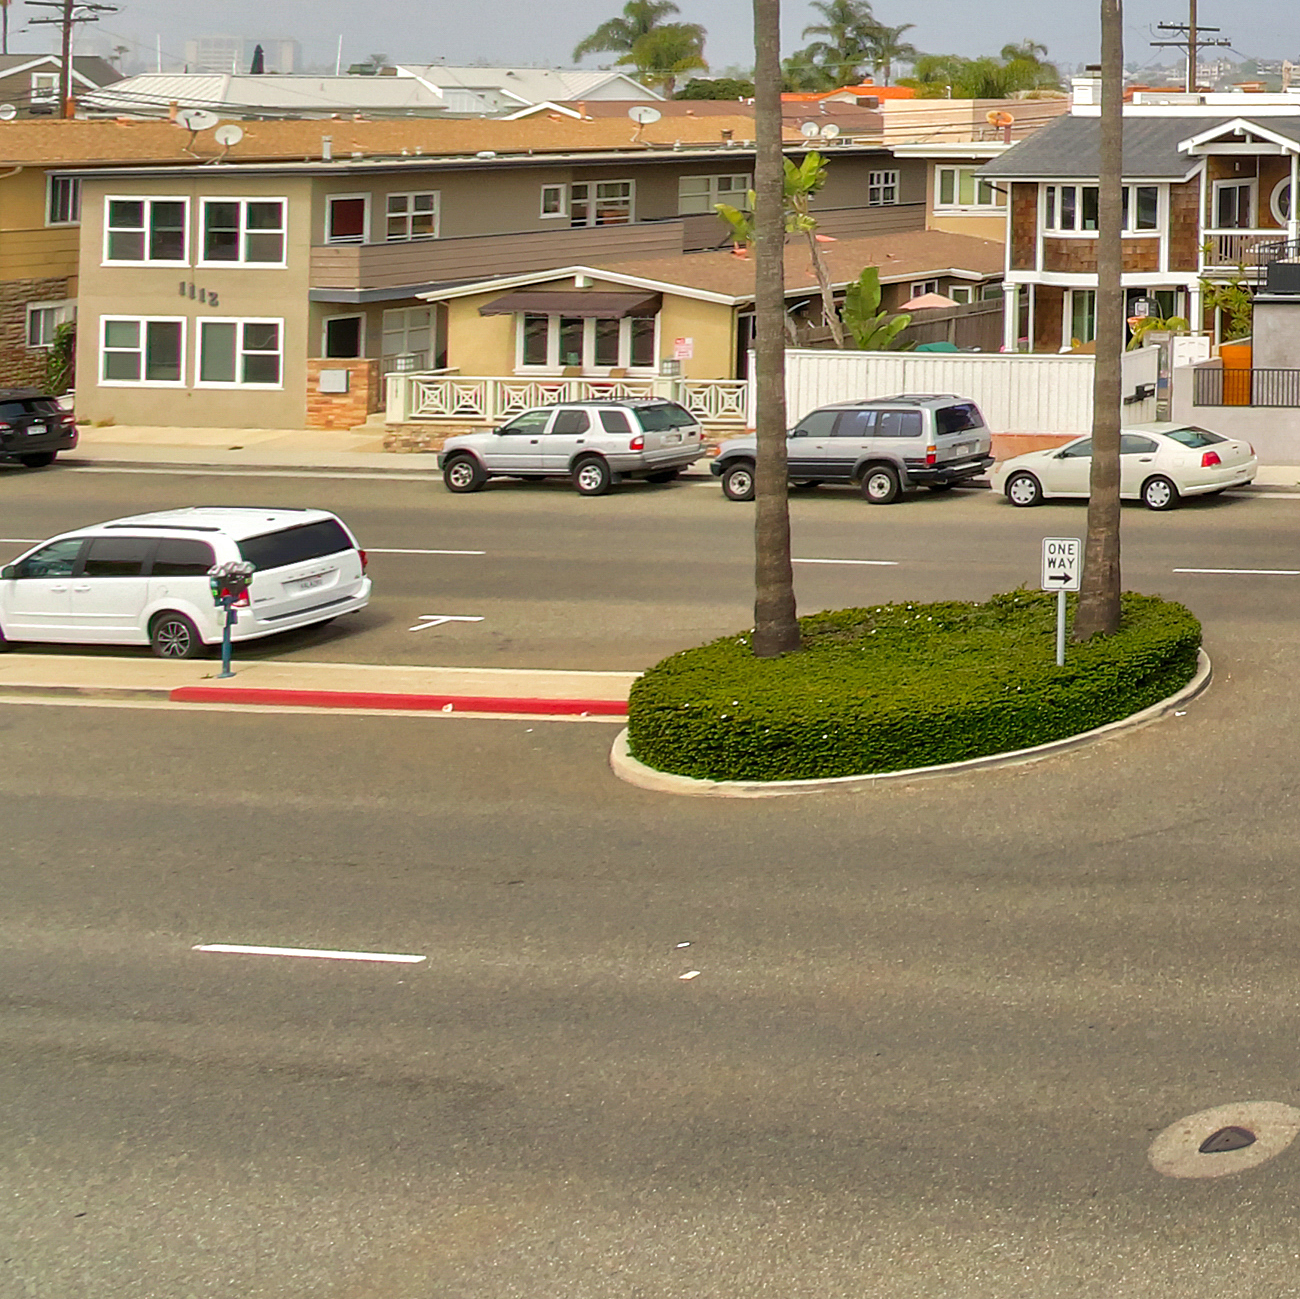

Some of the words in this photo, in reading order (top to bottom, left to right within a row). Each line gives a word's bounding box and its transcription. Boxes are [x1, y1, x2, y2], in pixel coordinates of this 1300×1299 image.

[179, 281, 219, 307] 1112
[1048, 543, 1075, 555] ONE
[1047, 557, 1075, 569] WAY
